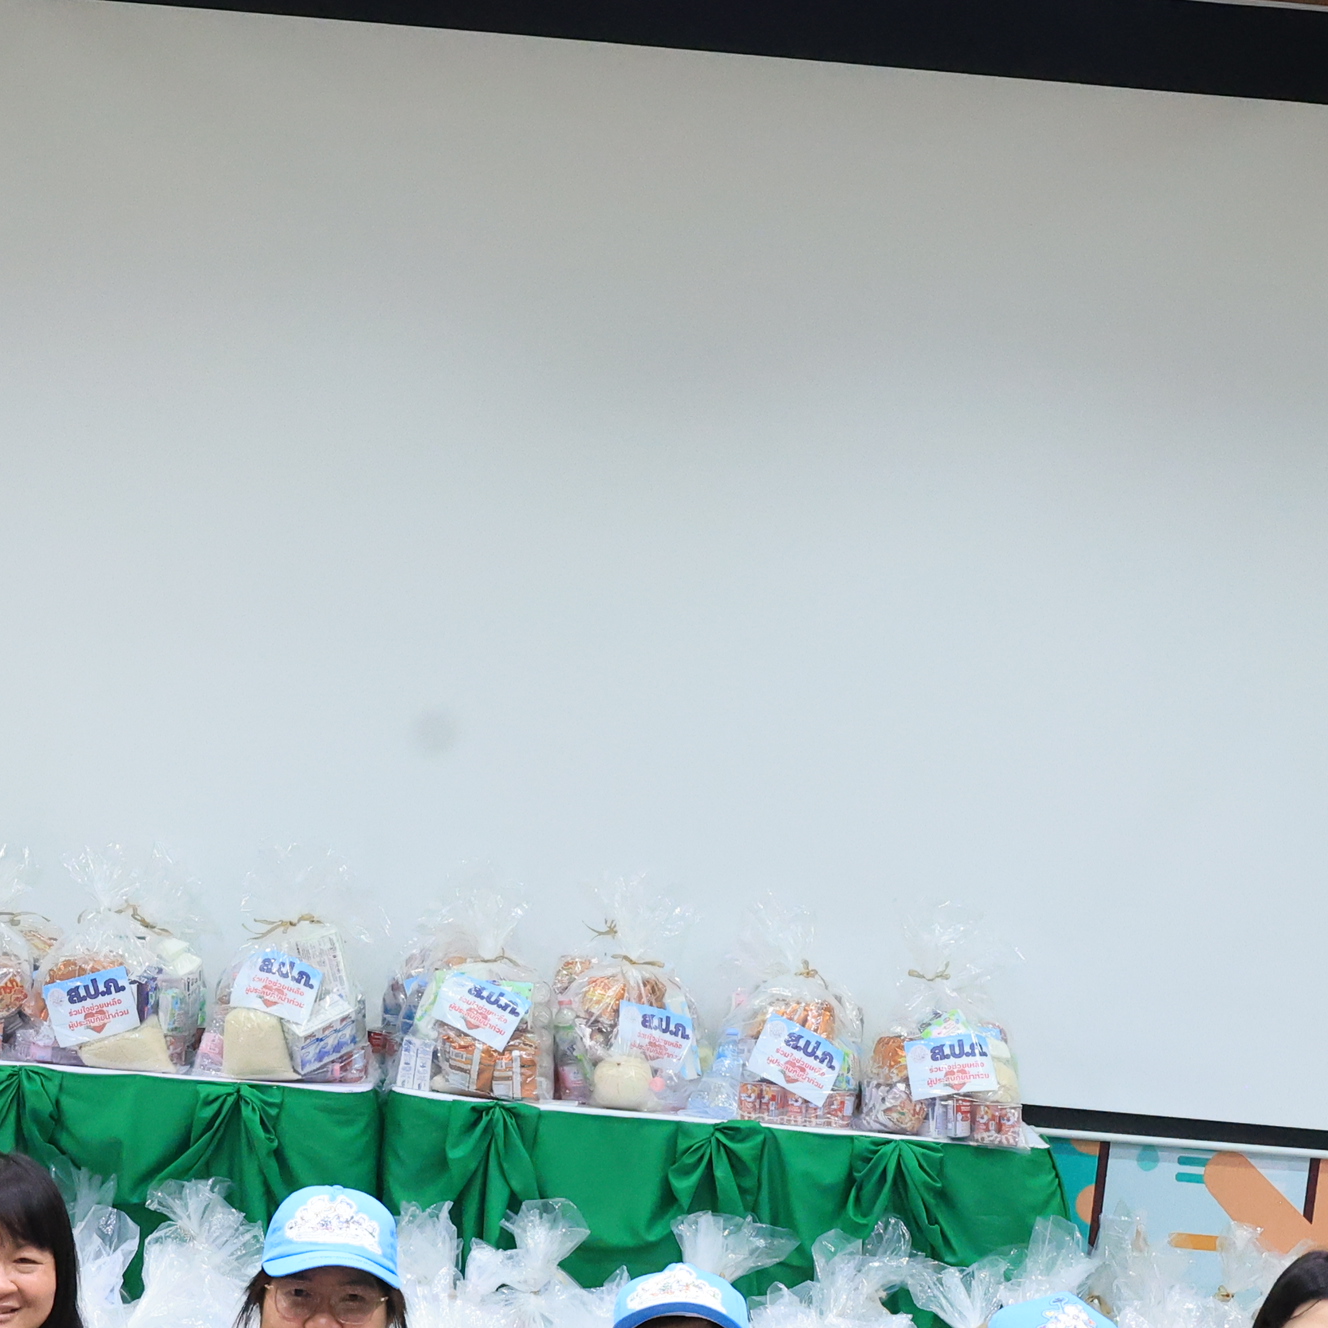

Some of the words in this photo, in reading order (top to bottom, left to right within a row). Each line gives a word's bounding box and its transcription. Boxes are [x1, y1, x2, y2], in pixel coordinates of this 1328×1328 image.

[259, 957, 315, 990] ส.ป.ก.
[67, 977, 126, 1005] ส.ป.ก.
[641, 1013, 690, 1040] ส.ป.ก.
[784, 1032, 836, 1071] ส.ป.ก.
